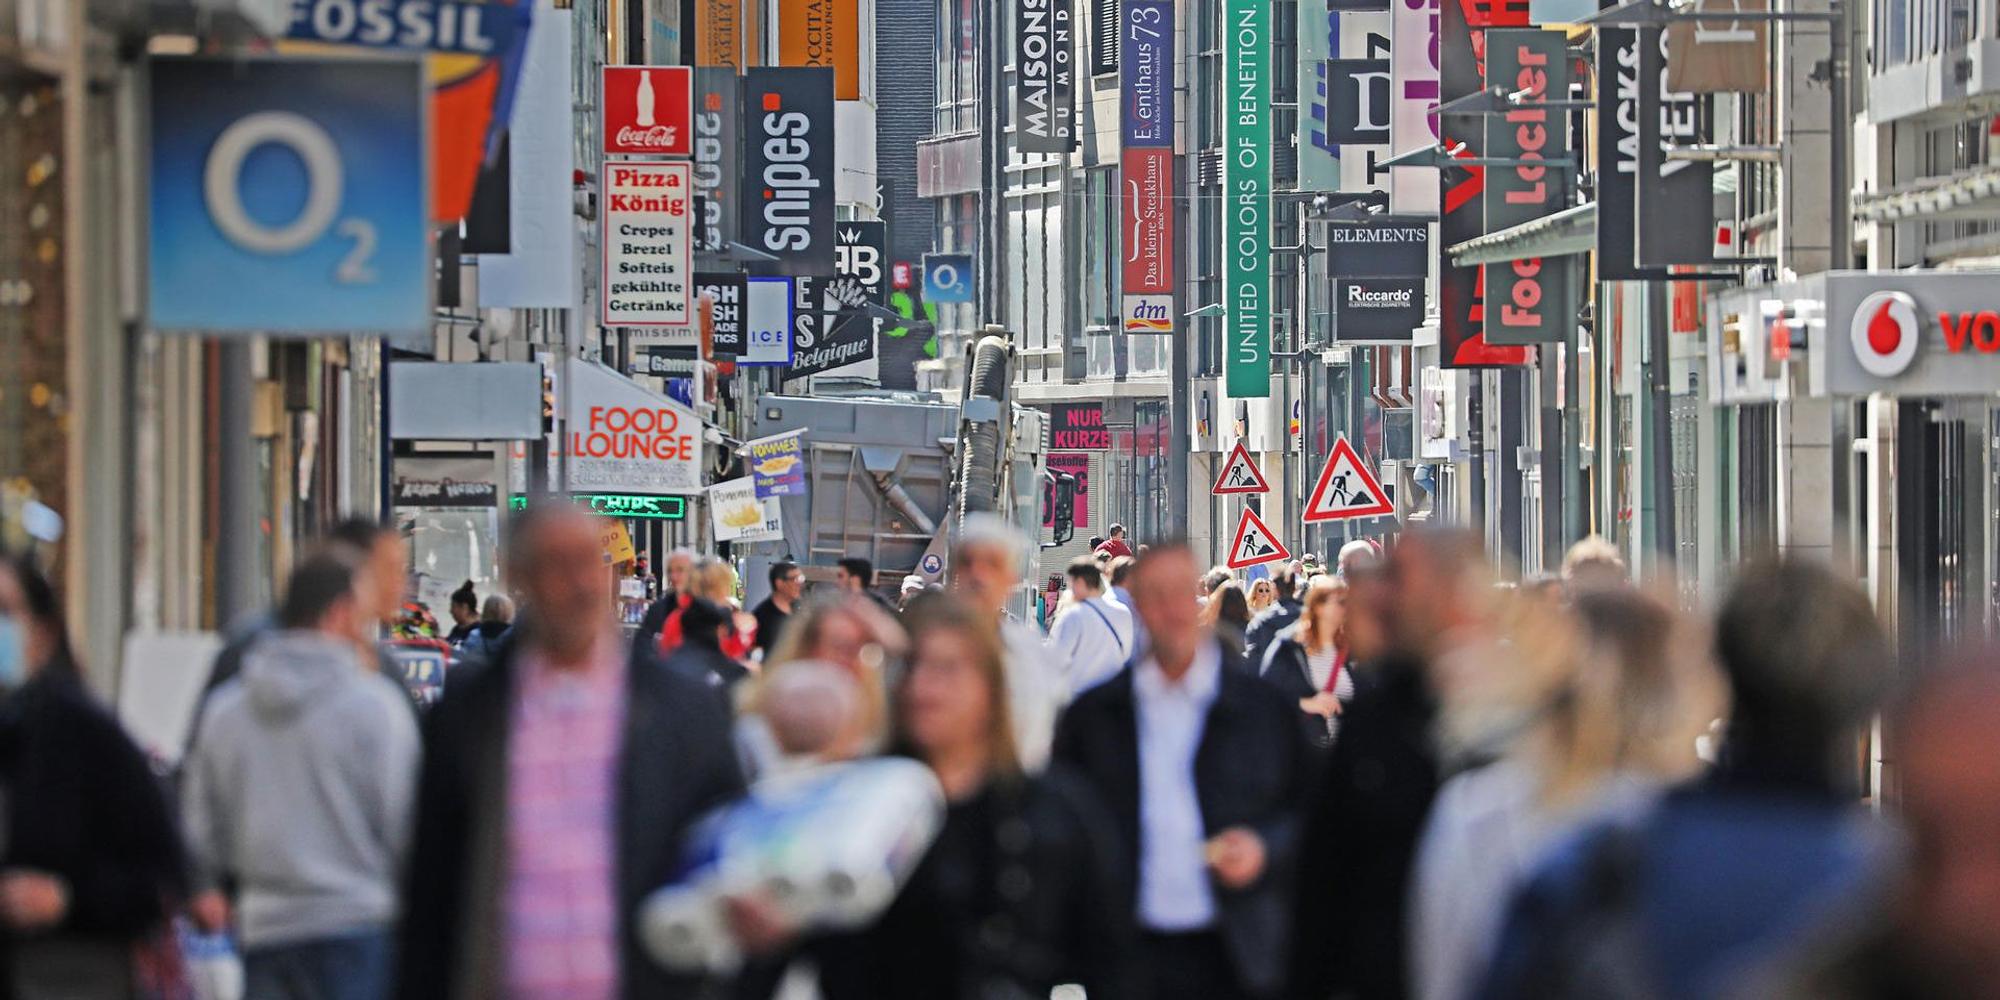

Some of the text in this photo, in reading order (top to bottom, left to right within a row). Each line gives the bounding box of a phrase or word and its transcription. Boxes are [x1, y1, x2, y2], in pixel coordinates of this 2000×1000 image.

[1056, 10, 1069, 138] DU MOND
[1130, 7, 1160, 139] Eventhaus 73
[614, 169, 680, 188] Pizza
[763, 112, 820, 251] snipes
[1239, 4, 1257, 363] UNITED COLORS OF BENETTON.
[610, 194, 684, 216] König
[620, 224, 674, 238] Crepes
[1144, 155, 1158, 287] Das kleine Steakhaus
[1333, 228, 1427, 242] ELEMENTS
[621, 243, 672, 255] Brezel
[619, 262, 674, 274] Softeis
[611, 281, 682, 295] gekühlte
[1501, 256, 1542, 327] Foo
[610, 300, 684, 312] Getränke
[1133, 299, 1166, 320] dm
[714, 322, 738, 332] ADE
[714, 334, 738, 344] TICS
[791, 337, 868, 372] Belgique
[590, 406, 678, 434] FOOD
[1067, 409, 1103, 426] NUR
[574, 432, 692, 460] LOUNGE
[1055, 430, 1108, 448] KURZE
